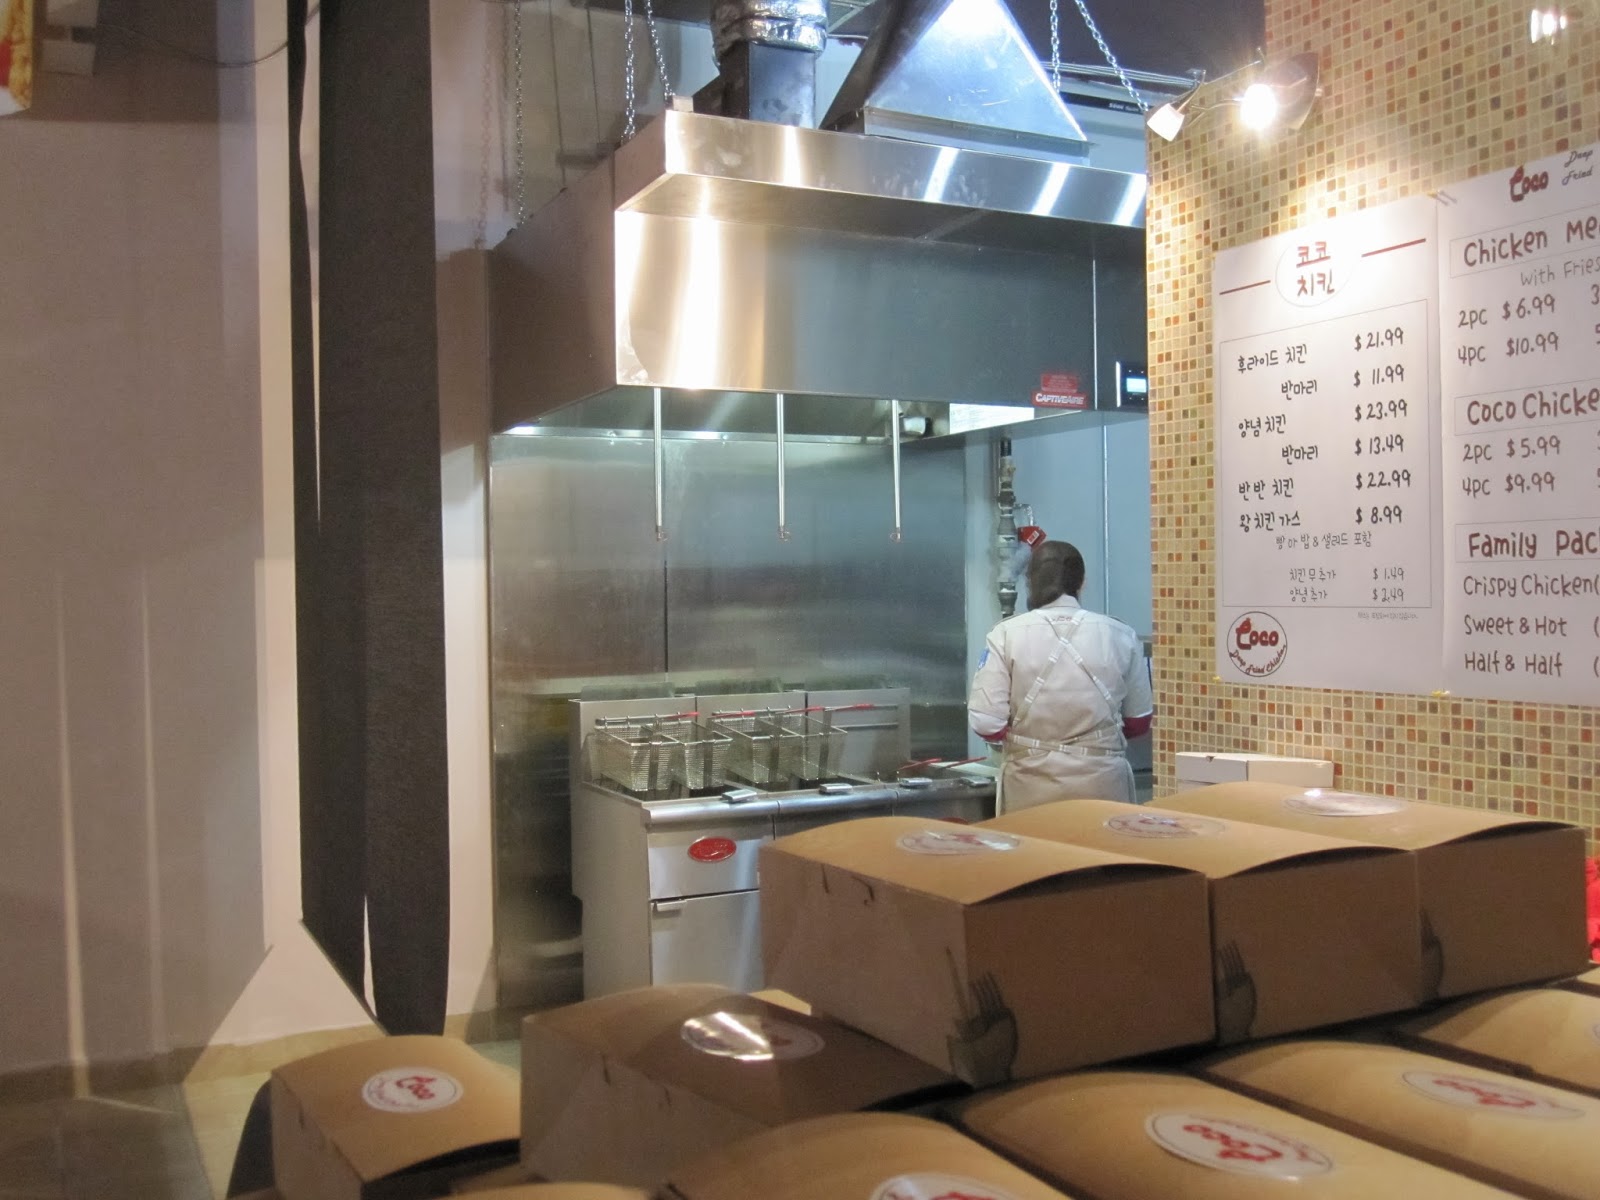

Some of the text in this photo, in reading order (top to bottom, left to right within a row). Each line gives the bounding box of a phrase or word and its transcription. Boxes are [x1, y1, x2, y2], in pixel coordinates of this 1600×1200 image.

[1509, 165, 1549, 202] Coco
[1464, 215, 1600, 267] Chicken Me
[1296, 241, 1331, 269] 코코
[1297, 268, 1335, 297] 치킨
[1520, 264, 1555, 287] with
[1506, 331, 1559, 357] $10.99
[1237, 350, 1279, 374] 후라이드
[1285, 343, 1308, 364] 치킨
[1281, 379, 1318, 400] 반마리
[1467, 400, 1516, 425] Coco
[1281, 445, 1319, 465] 반마리
[1505, 471, 1555, 493] $9.99
[1468, 528, 1600, 559] Family Pac
[1463, 575, 1517, 598] Crispy
[1235, 617, 1280, 651] Coco
[1464, 613, 1515, 636] Sweet
[1535, 615, 1568, 637] Hot
[1464, 650, 1500, 675] Half
[1524, 651, 1564, 678] Half
